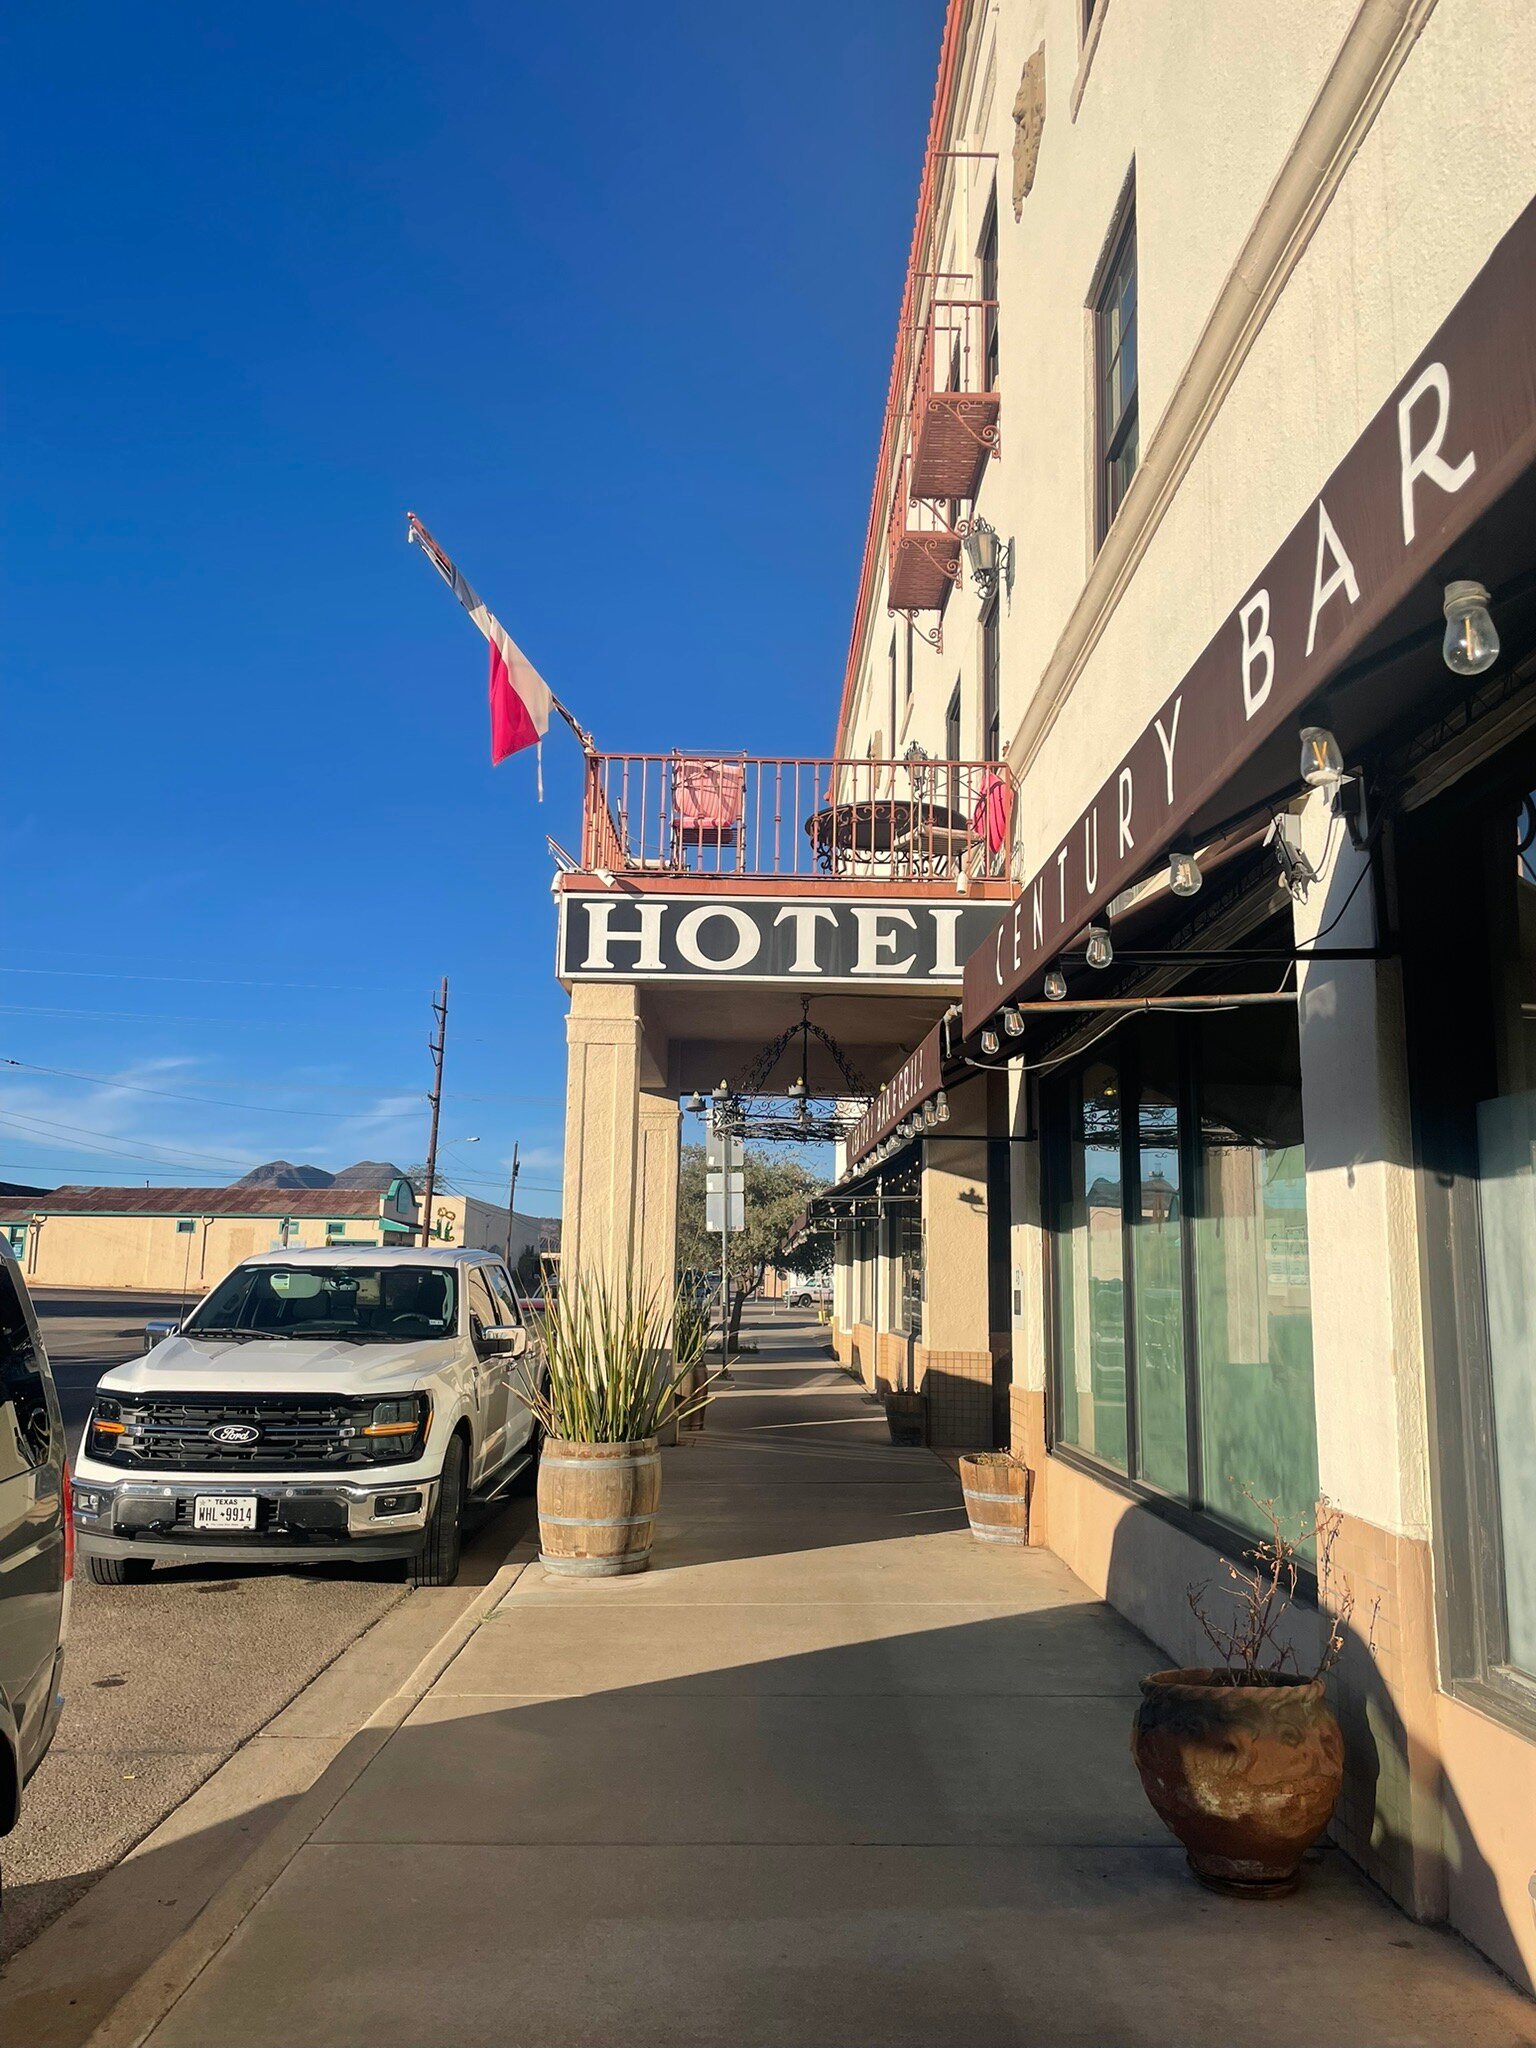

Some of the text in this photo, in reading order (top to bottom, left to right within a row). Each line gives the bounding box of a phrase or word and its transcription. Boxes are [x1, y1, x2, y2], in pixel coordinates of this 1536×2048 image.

[996, 362, 1476, 986] CENTURY BAR
[580, 903, 964, 975] HOTEL
[898, 1049, 924, 1110] GRILL
[220, 1427, 250, 1440] Ford
[225, 1507, 252, 1521] 9914
